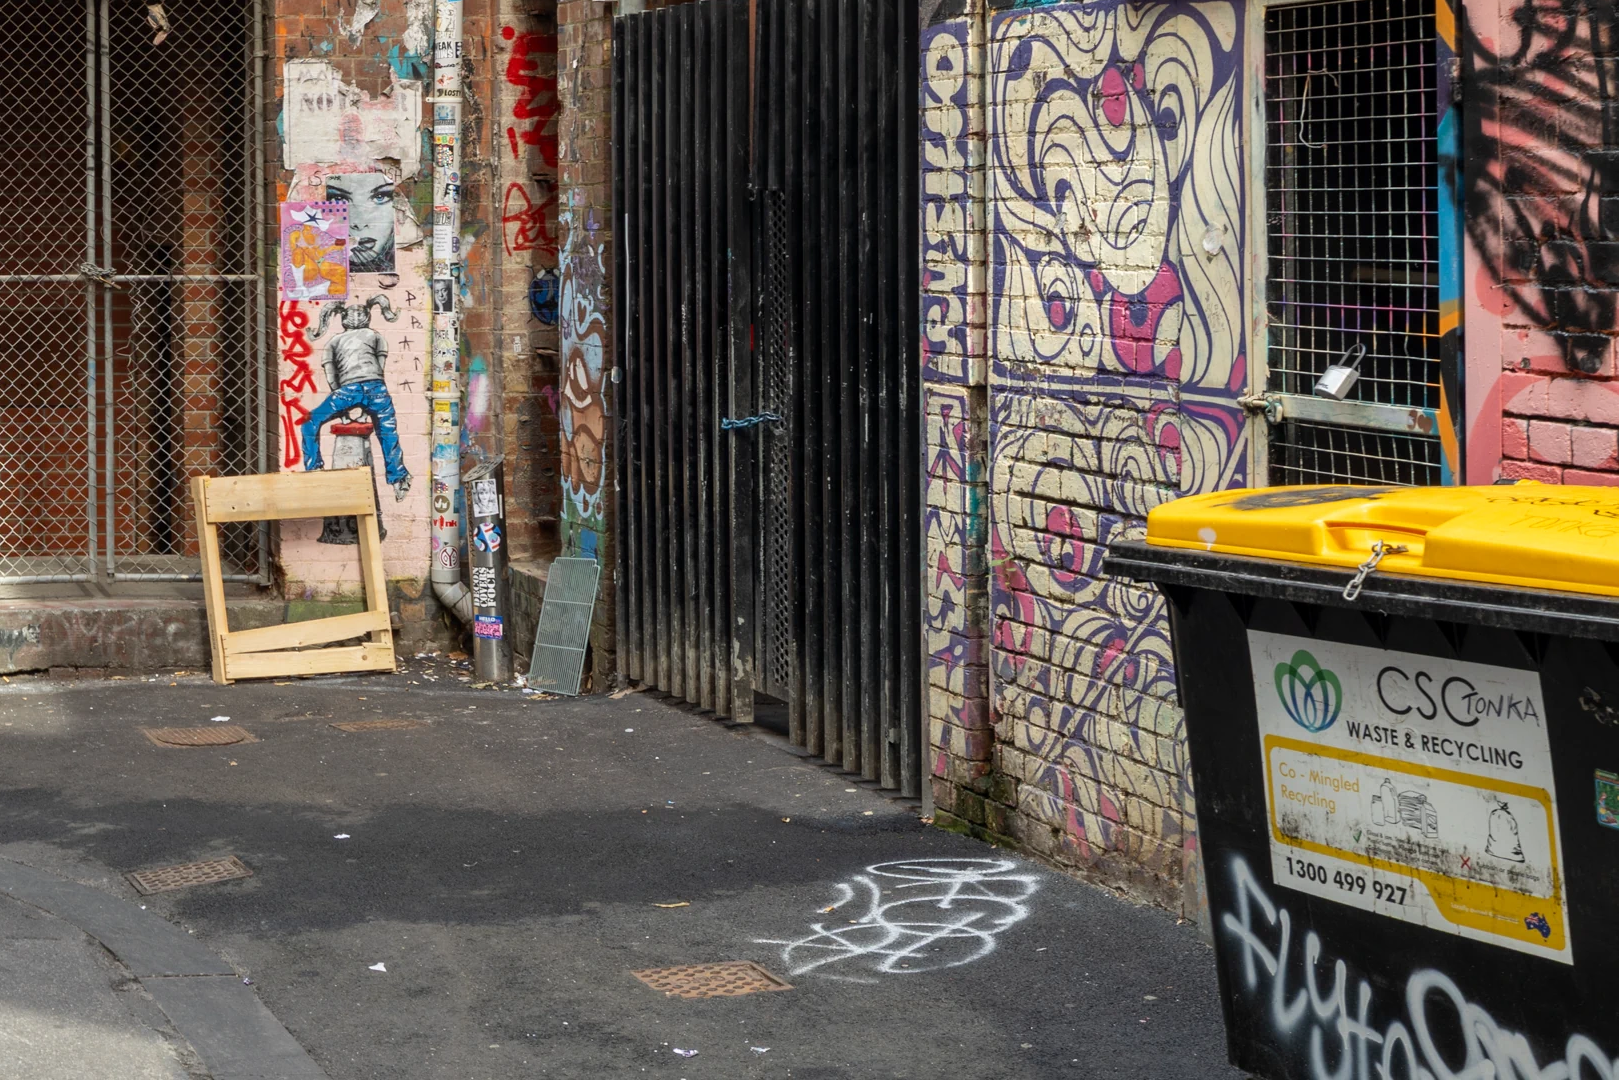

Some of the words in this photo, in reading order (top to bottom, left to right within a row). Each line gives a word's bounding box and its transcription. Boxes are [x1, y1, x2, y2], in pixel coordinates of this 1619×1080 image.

[479, 566, 488, 608] COVERS
[486, 566, 497, 607] FOCK
[1346, 720, 1399, 746] WASTE
[1404, 732, 1415, 749] &
[1421, 734, 1524, 770] RECYCLING
[1279, 762, 1296, 779] Co
[1309, 769, 1360, 793] Mingled
[1281, 785, 1337, 814] Recycling
[1286, 856, 1328, 884] 1300
[1334, 871, 1366, 895] 499
[1373, 881, 1407, 905] 927
